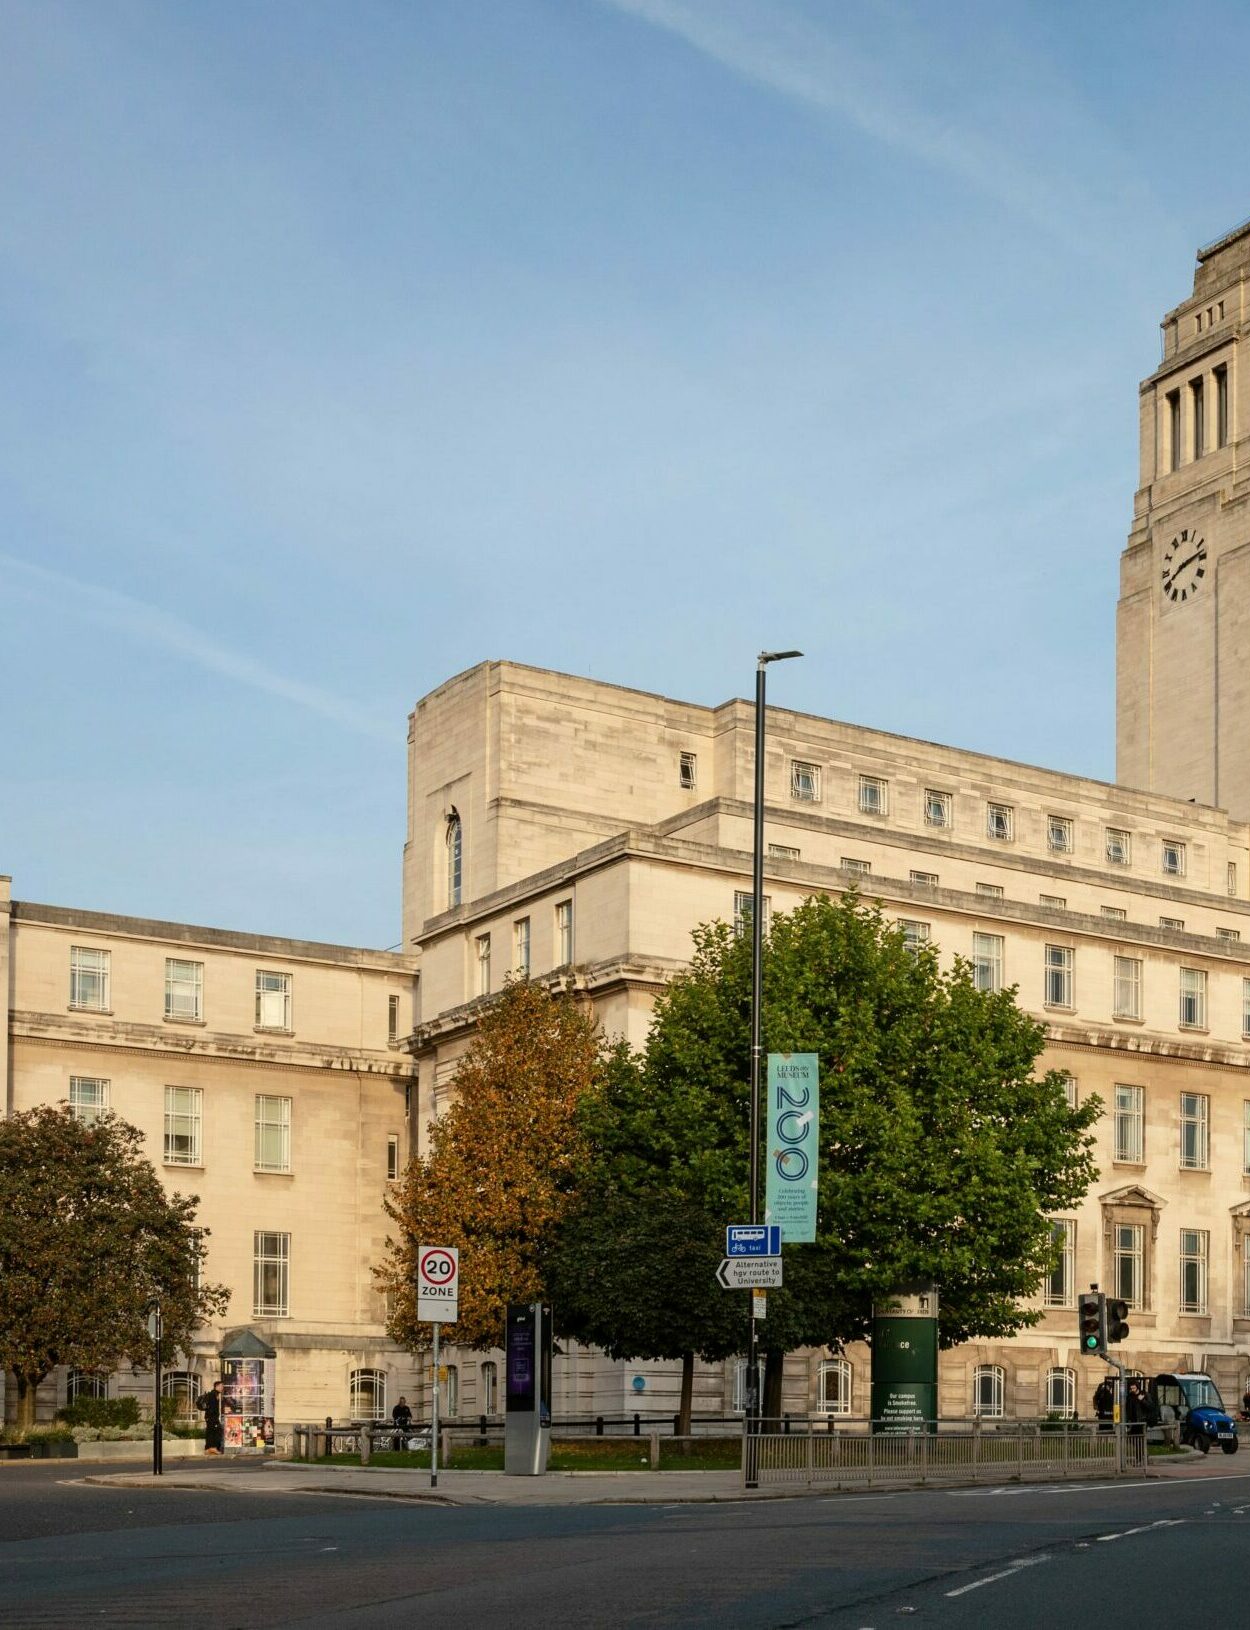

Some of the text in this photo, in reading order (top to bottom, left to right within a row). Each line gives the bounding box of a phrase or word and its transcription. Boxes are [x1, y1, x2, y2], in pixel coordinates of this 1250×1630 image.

[776, 1086, 810, 1181] 200
[427, 1260, 451, 1275] 20
[735, 1260, 778, 1268] Alternative
[733, 1270, 747, 1278] hgv
[422, 1287, 454, 1296] ZONE
